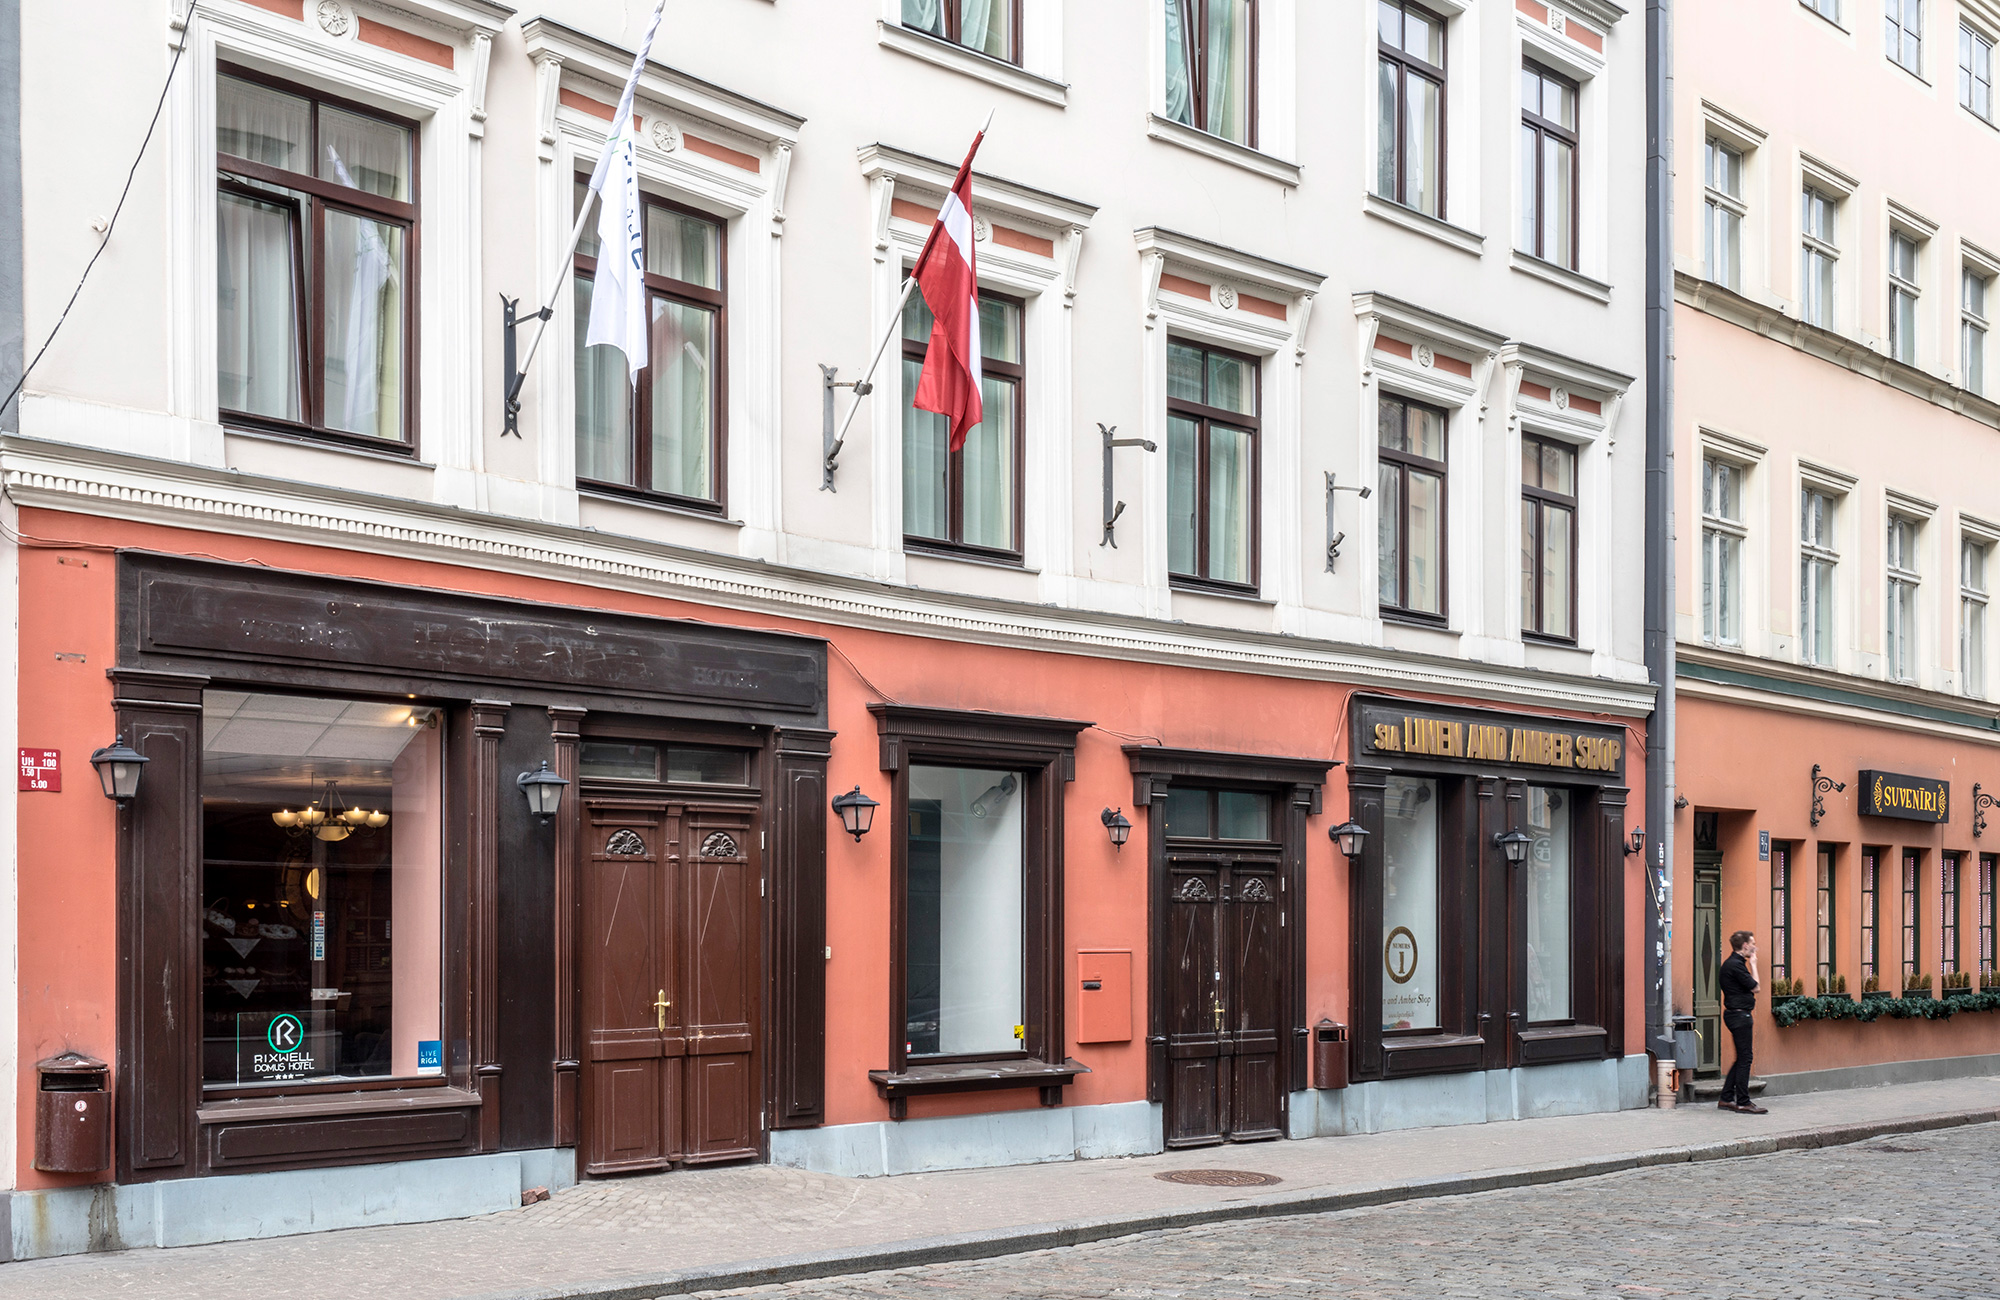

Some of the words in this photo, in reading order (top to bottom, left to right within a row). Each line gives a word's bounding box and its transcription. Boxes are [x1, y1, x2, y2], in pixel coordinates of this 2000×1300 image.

[1374, 723, 1401, 752] SIA
[1404, 716, 1464, 758] LINEN
[1466, 723, 1508, 762] AND
[1510, 728, 1573, 768] AMBER
[1575, 735, 1622, 772] SHOP
[22, 757, 34, 766] UH
[42, 758, 57, 767] 100
[21, 768, 35, 776] 1.50
[31, 780, 48, 788] 5.00
[1884, 785, 1937, 812] SUVENĪRI
[1398, 994, 1417, 1005] Amber
[1417, 994, 1431, 1006] Shop
[254, 1052, 315, 1064] RIXWELL
[254, 1062, 286, 1073] DOMUS
[288, 1061, 315, 1071] HOTEL
